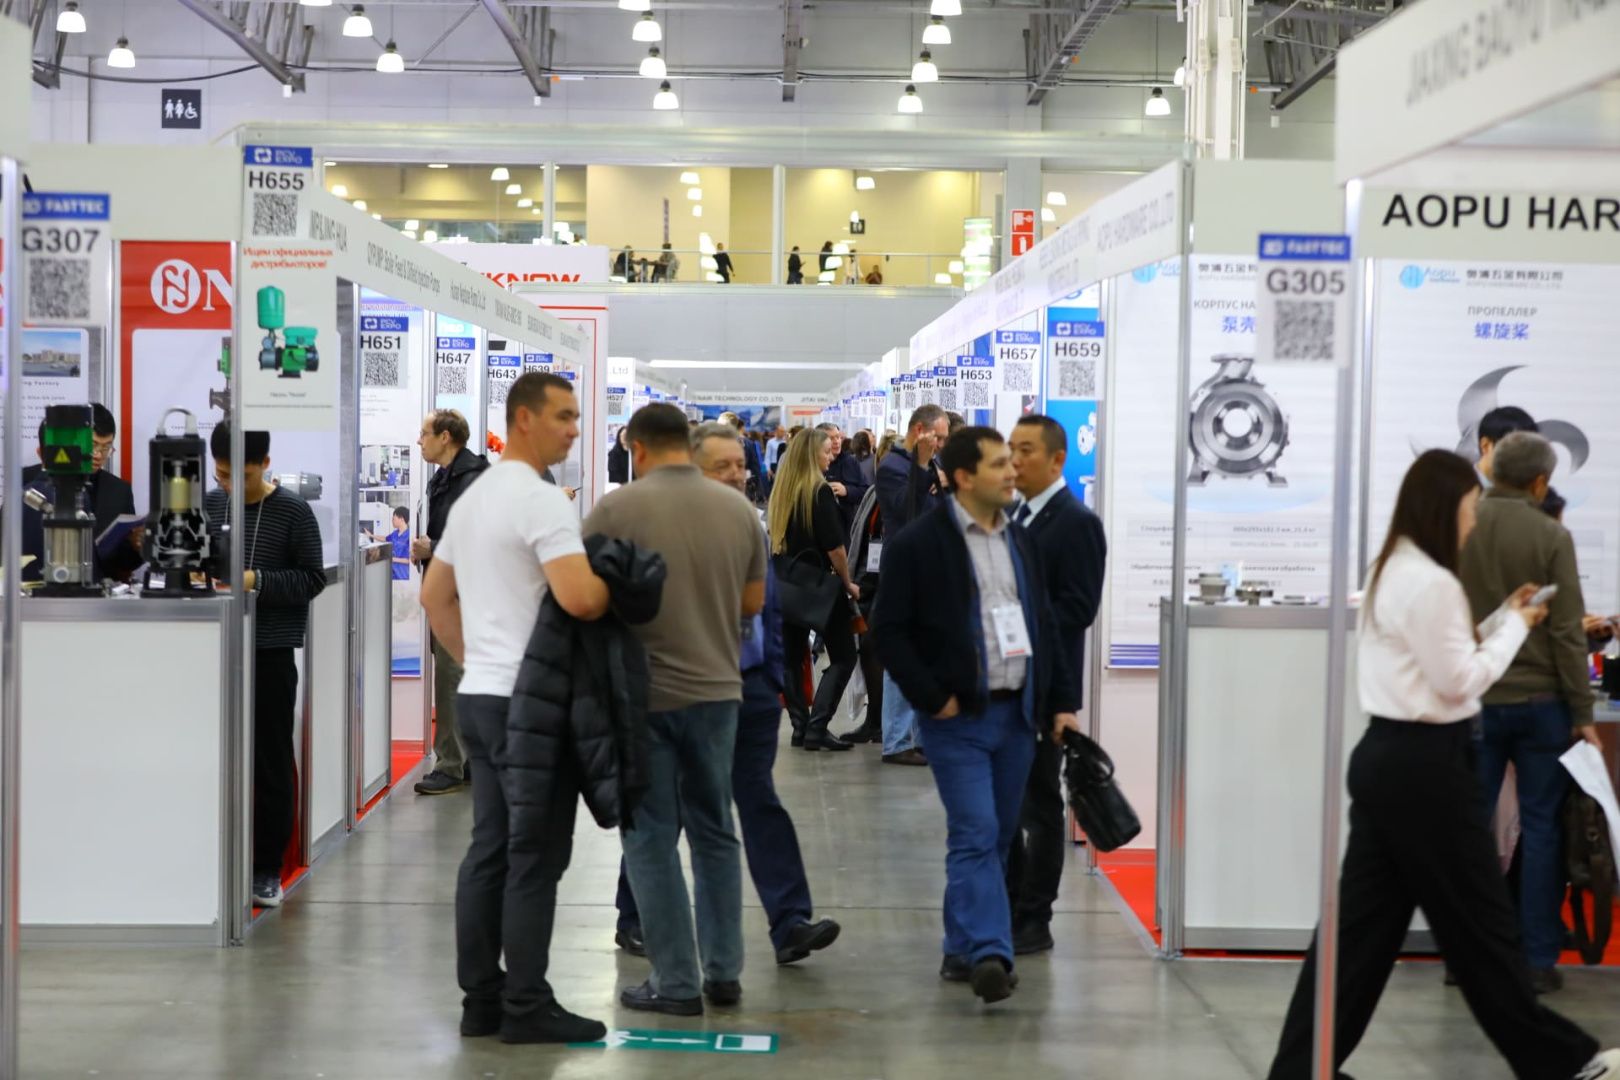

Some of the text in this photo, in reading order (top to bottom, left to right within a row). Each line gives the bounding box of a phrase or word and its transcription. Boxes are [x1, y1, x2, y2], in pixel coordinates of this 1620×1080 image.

[249, 171, 304, 191] H655
[1382, 194, 1620, 231] AOPU HAR
[22, 226, 101, 253] G307
[272, 248, 333, 258] официальных
[1266, 268, 1345, 295] G305
[1194, 299, 1257, 310] КОРПУС НА
[1468, 306, 1537, 317] ПРОПЕЛЛЕР
[360, 335, 401, 350] H651
[1000, 347, 1037, 360] H657
[1055, 342, 1101, 357] H659
[436, 351, 471, 365] H647
[488, 368, 517, 379] H643
[960, 369, 993, 380] H653
[937, 378, 957, 388] H64
